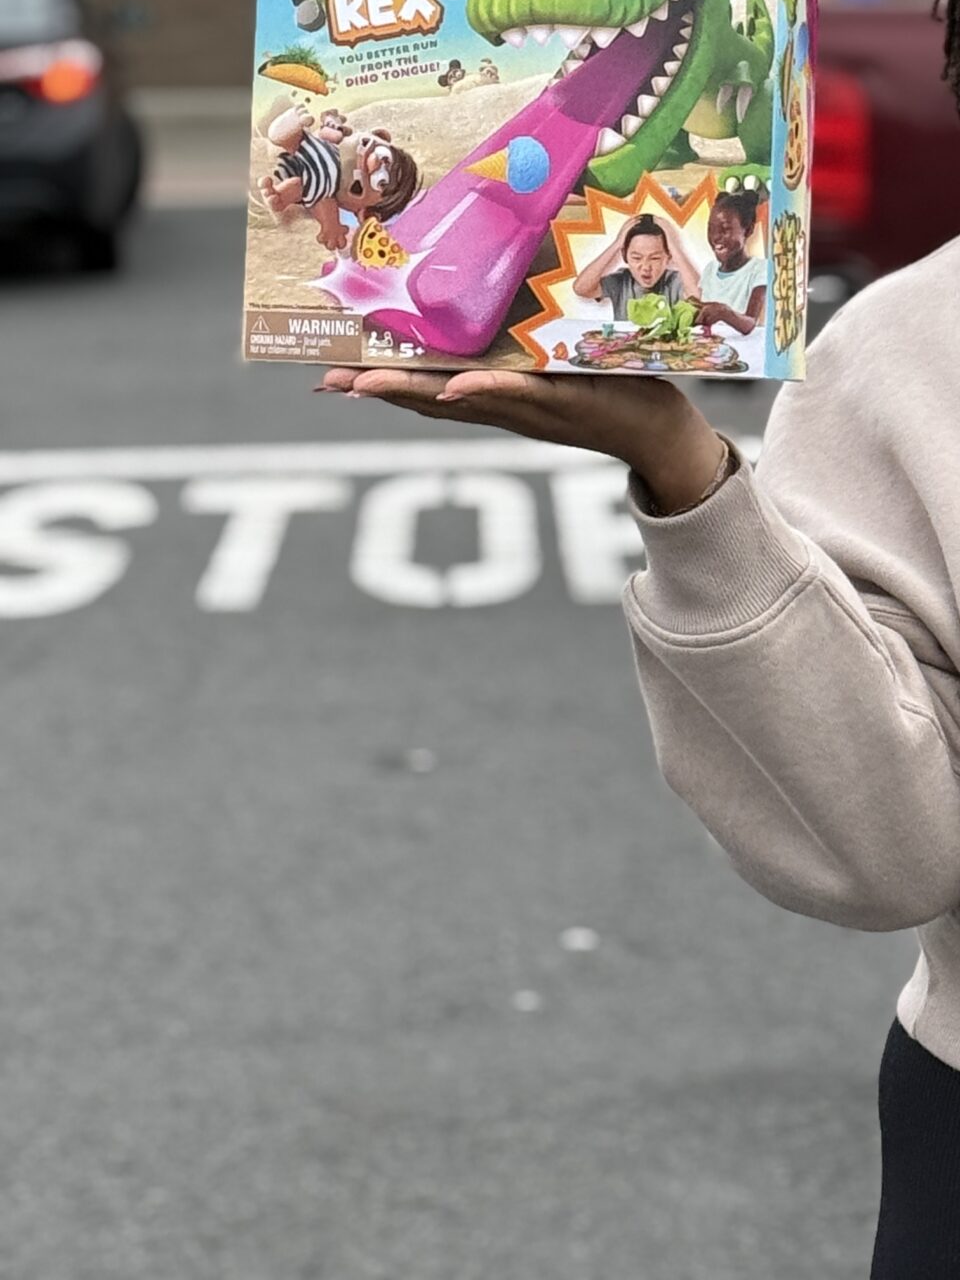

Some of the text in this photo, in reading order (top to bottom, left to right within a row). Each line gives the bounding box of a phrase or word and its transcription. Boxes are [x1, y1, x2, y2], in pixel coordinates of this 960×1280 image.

[339, 40, 438, 65] YOU BETTER RUN
[361, 55, 419, 73] FROM THE
[345, 62, 440, 88] DINO TONGUE!
[288, 318, 360, 336] WARNING:
[398, 342, 426, 359] 5+
